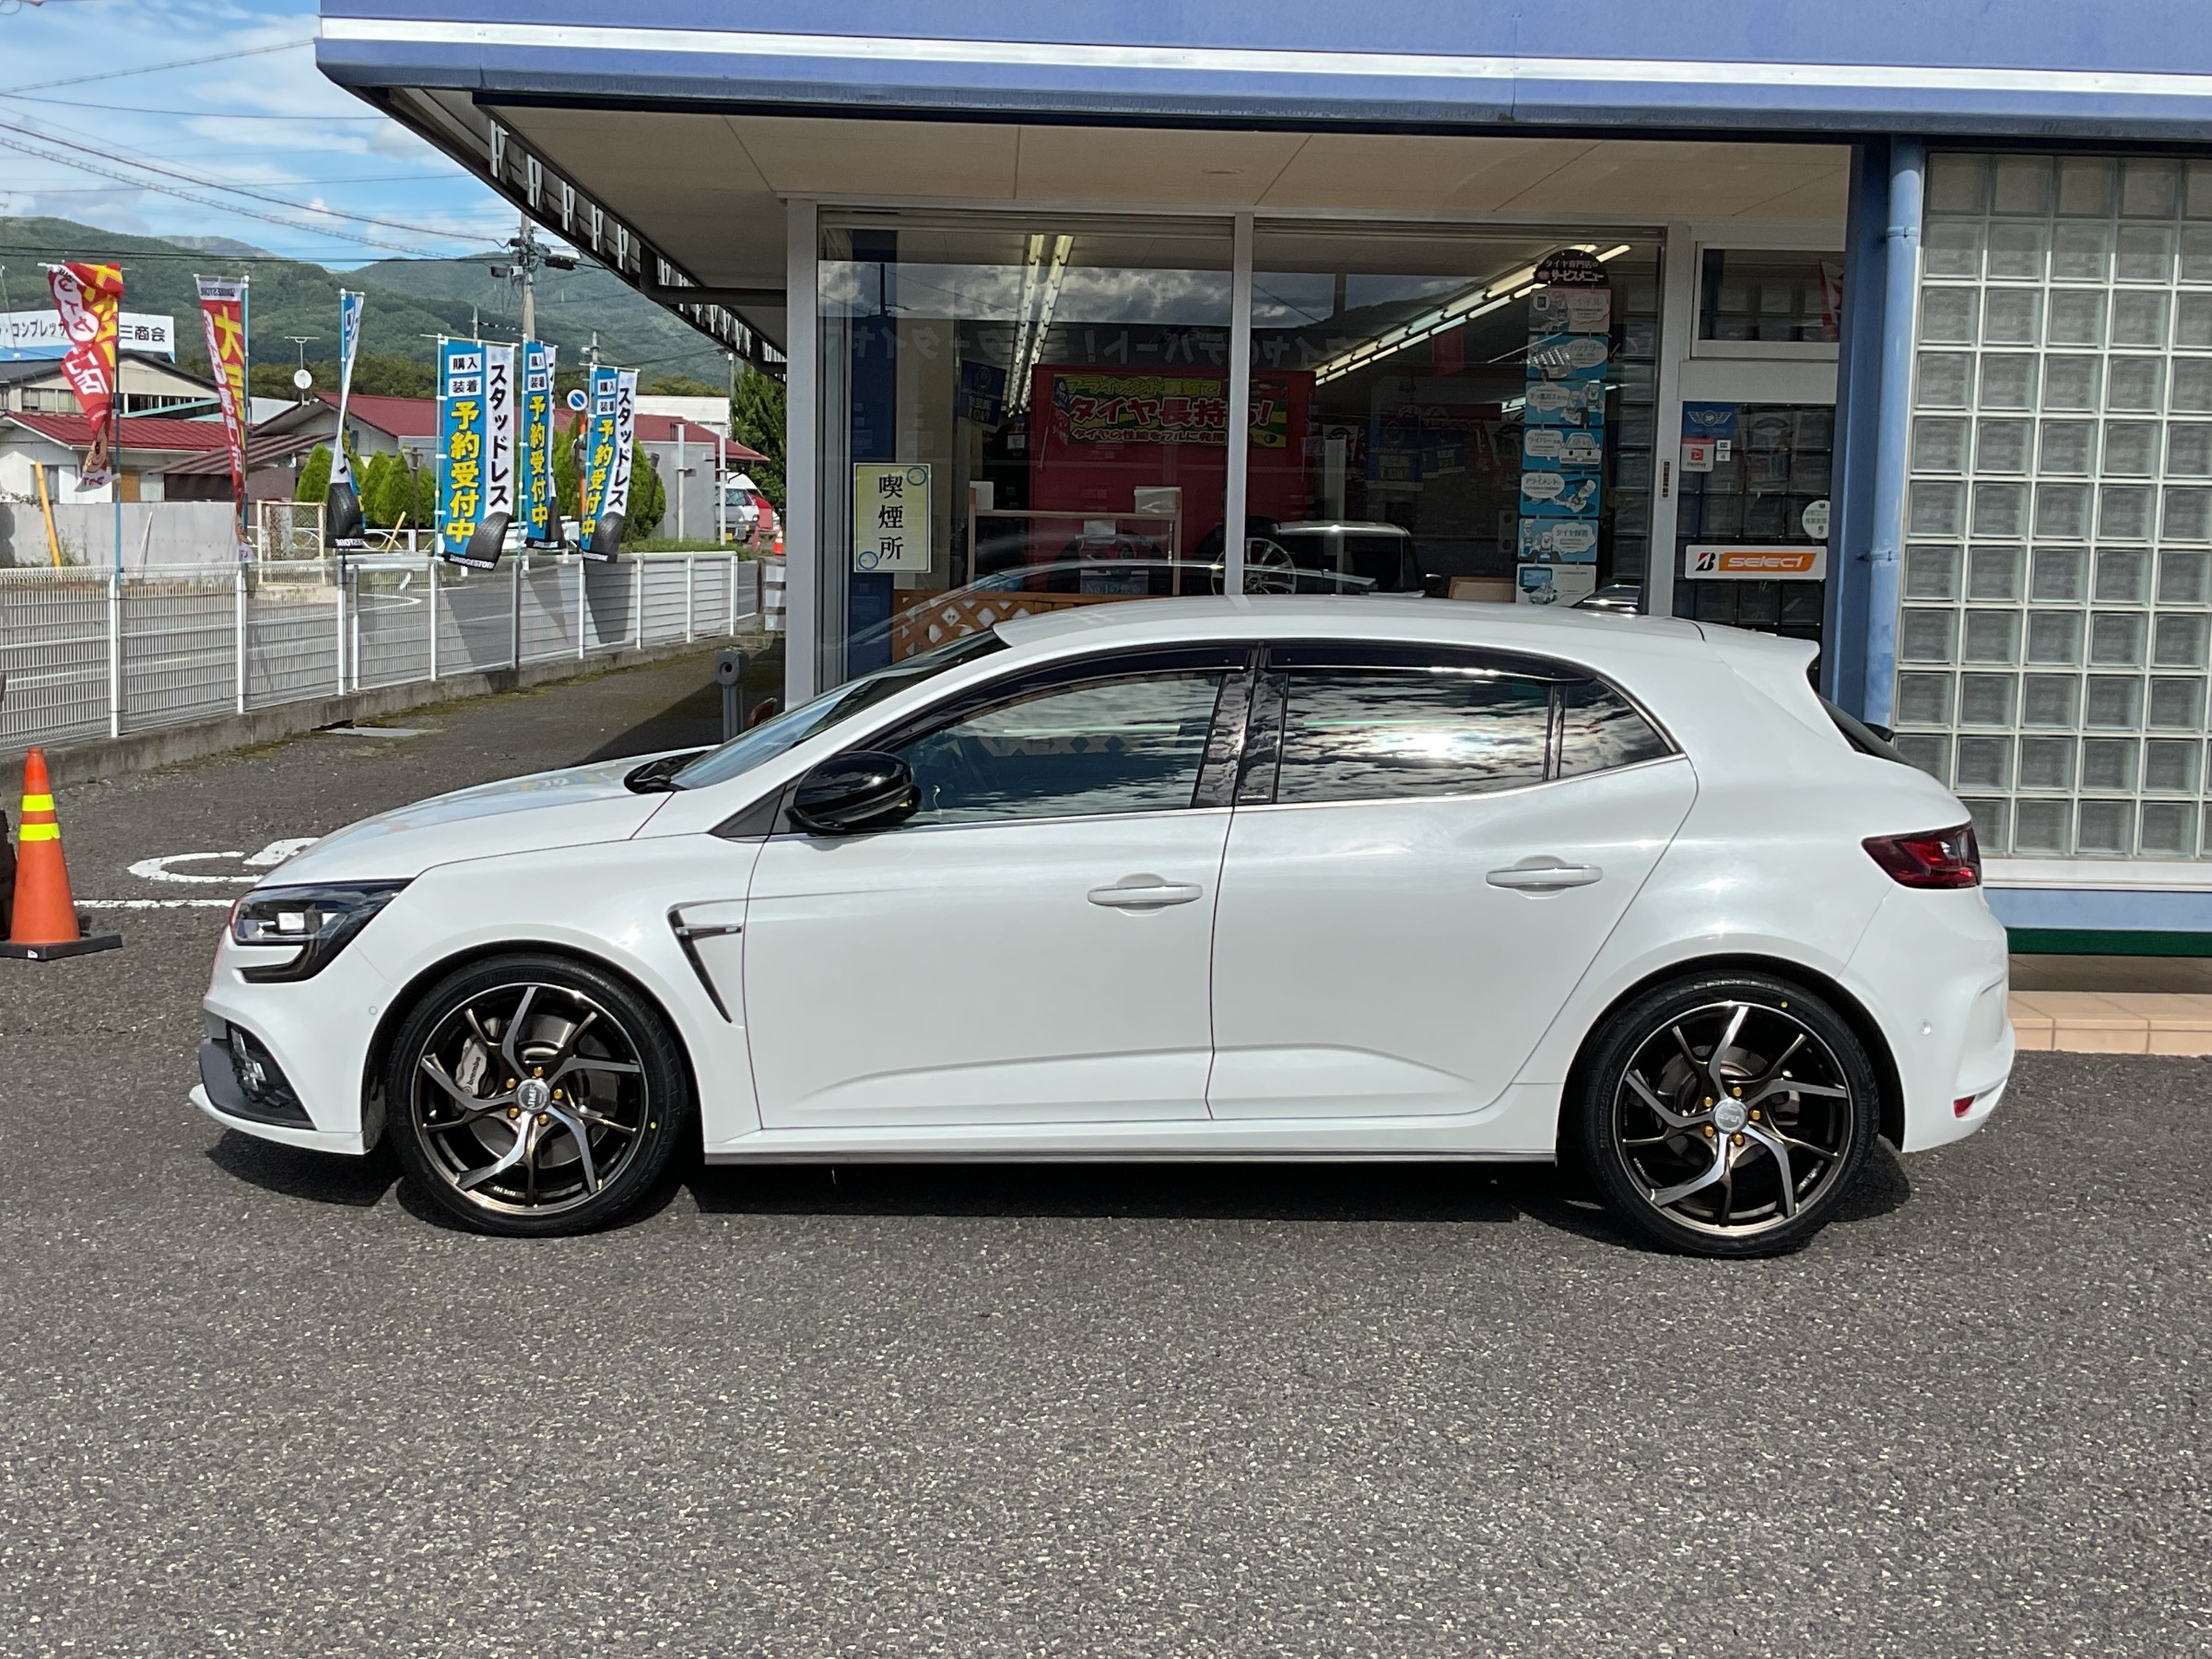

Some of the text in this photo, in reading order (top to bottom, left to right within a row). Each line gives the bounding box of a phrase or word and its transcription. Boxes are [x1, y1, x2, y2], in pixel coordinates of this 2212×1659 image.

[120, 324, 166, 342] 三商会
[453, 357, 477, 370] 購入
[453, 380, 477, 393] 装着
[530, 376, 546, 389] 装着
[600, 380, 616, 393] 購入
[600, 400, 615, 413] 装着
[489, 364, 510, 507] スタッドレス
[606, 387, 632, 507] スタッドレス
[446, 400, 481, 543] 予約受付中
[529, 394, 548, 529] 予約受付中
[582, 418, 615, 540] 予約受付中
[878, 474, 904, 560] 喫煙所
[1727, 555, 1805, 569] select
[467, 1056, 480, 1087] brembo
[1600, 1066, 1617, 1149] BRIDGESTONE
